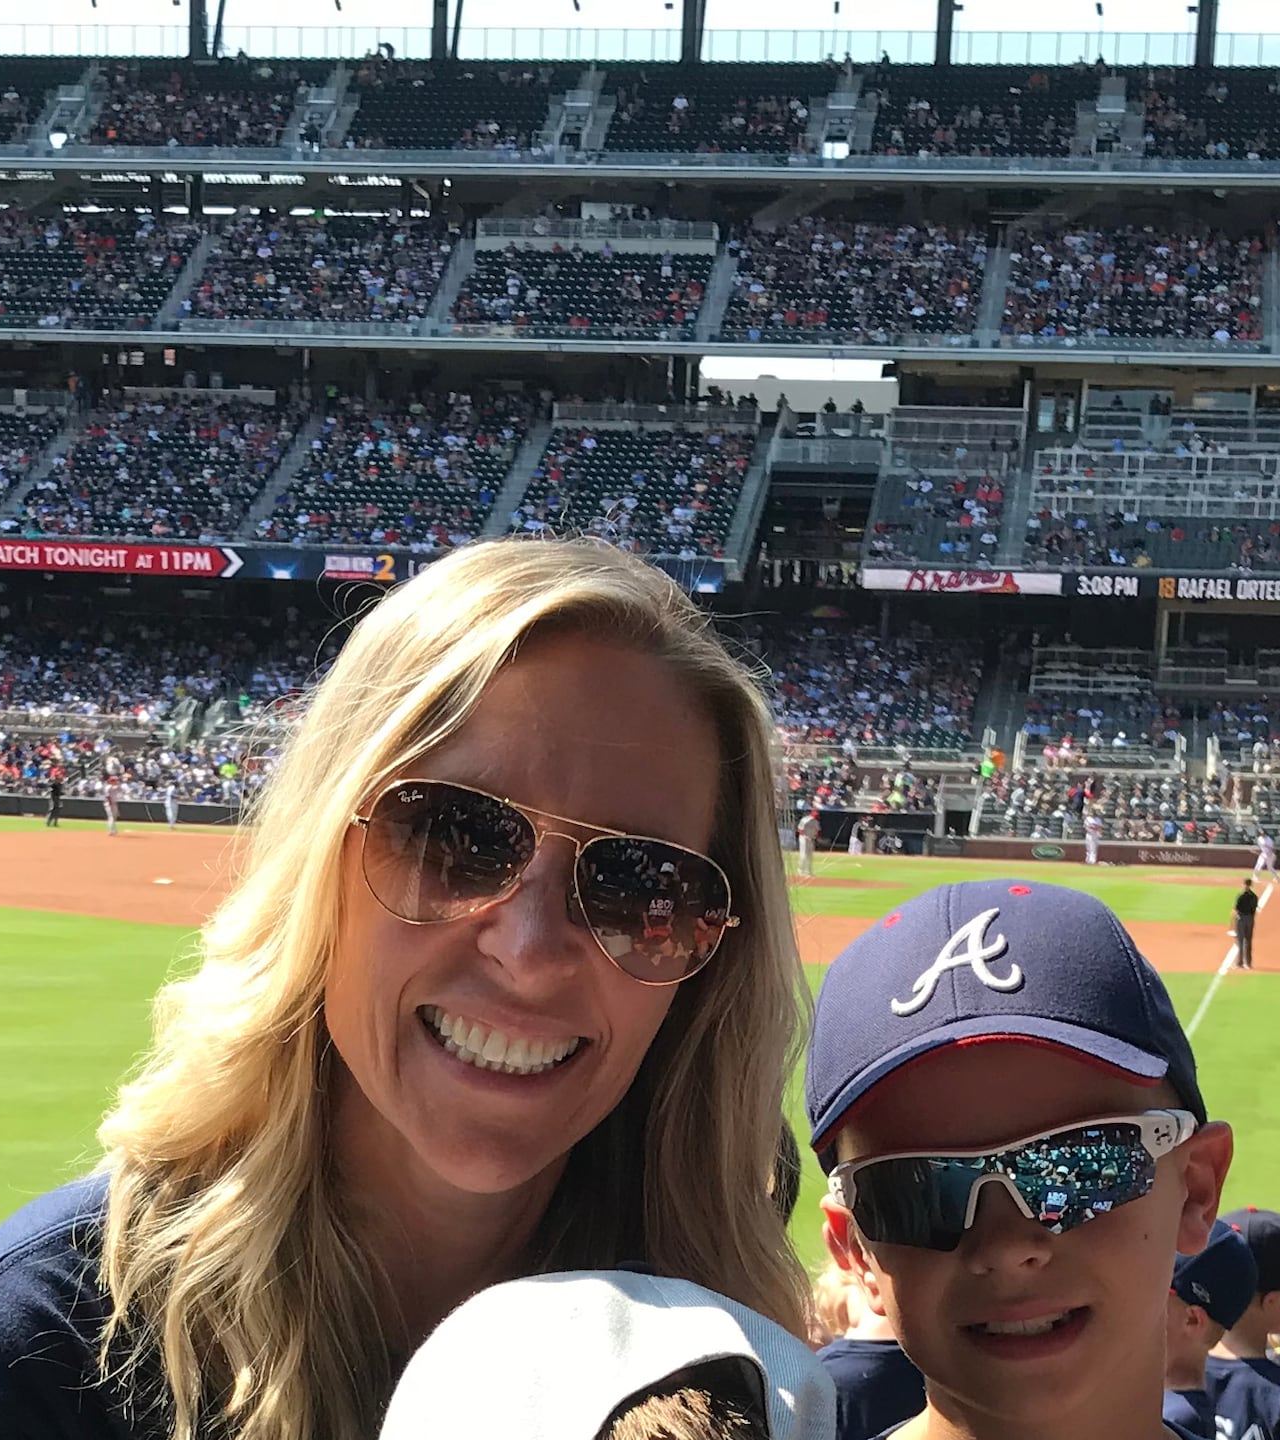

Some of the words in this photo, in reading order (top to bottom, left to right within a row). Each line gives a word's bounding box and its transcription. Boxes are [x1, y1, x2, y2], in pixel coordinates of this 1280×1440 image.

[44, 547, 128, 567] TONIGHT
[135, 554, 153, 569] AT
[160, 551, 212, 571] 11PM
[374, 554, 396, 580] 2
[1077, 575, 1112, 596] 3:08
[1114, 577, 1138, 597] PM
[1177, 578, 1233, 600] RAFAEL
[891, 907, 1022, 1017] A
